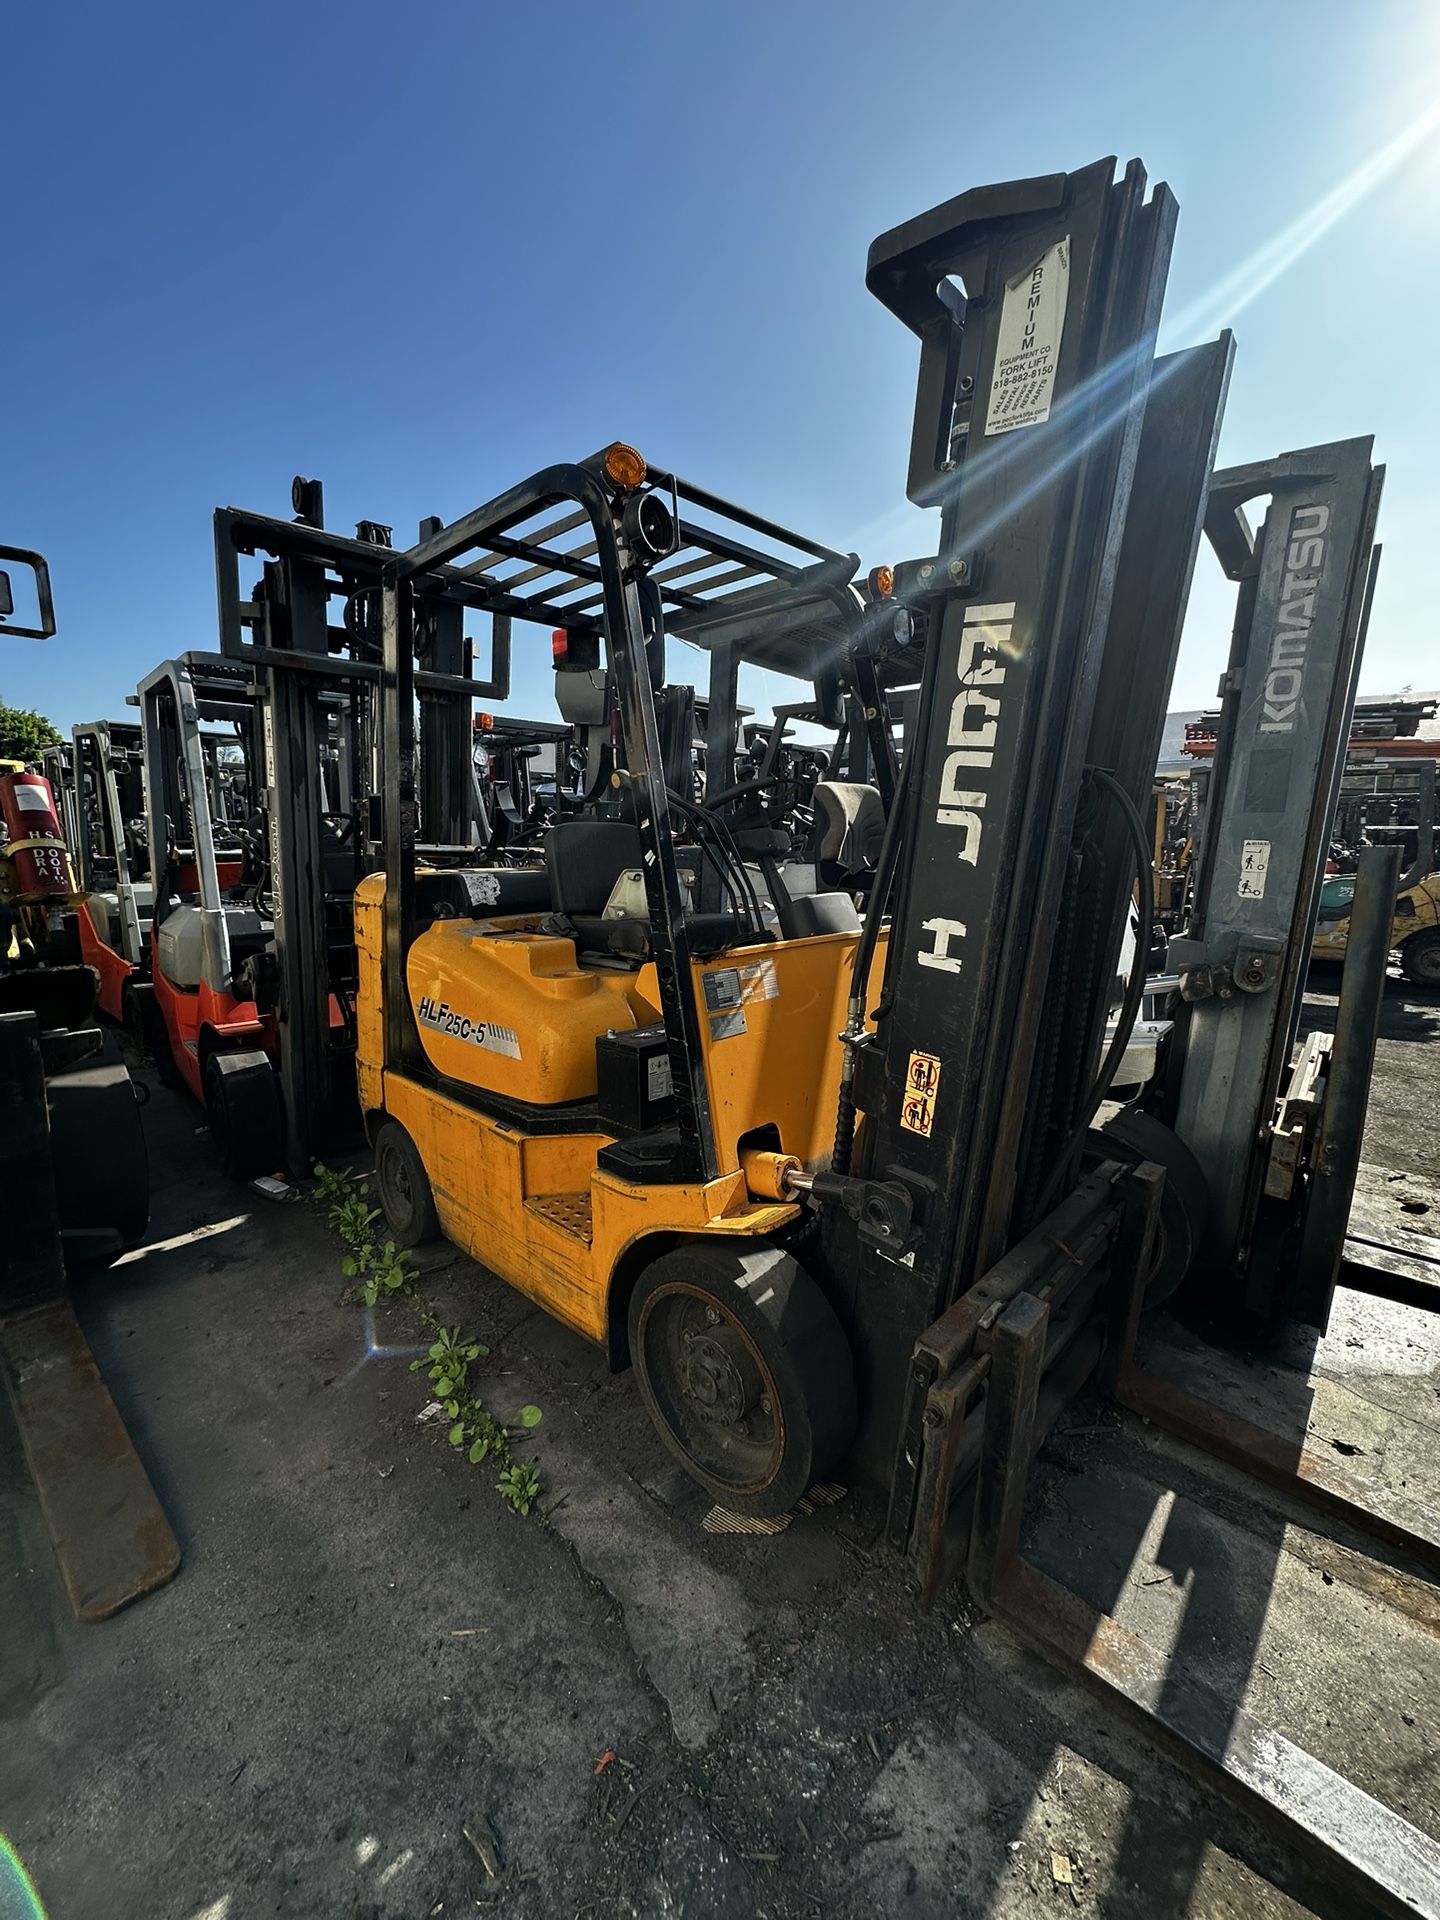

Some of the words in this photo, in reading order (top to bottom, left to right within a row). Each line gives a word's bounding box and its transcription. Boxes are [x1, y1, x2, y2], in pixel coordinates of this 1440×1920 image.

[1021, 267, 1043, 351] REMIUM
[999, 350, 1039, 368] EQUIPMENT
[1000, 362, 1026, 378] FORK
[1028, 355, 1049, 371] LIFT
[993, 365, 1053, 390] 818-882-8150
[1030, 378, 1048, 405] PARTS
[992, 389, 1009, 415] SALES
[1001, 384, 1021, 415] RENTAL
[1011, 382, 1029, 412] SERVICE
[1019, 380, 1038, 410] REPAIR
[1260, 504, 1330, 732] KOMATSU
[917, 601, 1016, 973] HUNDAI
[28, 830, 48, 876] HDRA
[418, 996, 486, 1044] HLF25C-5
